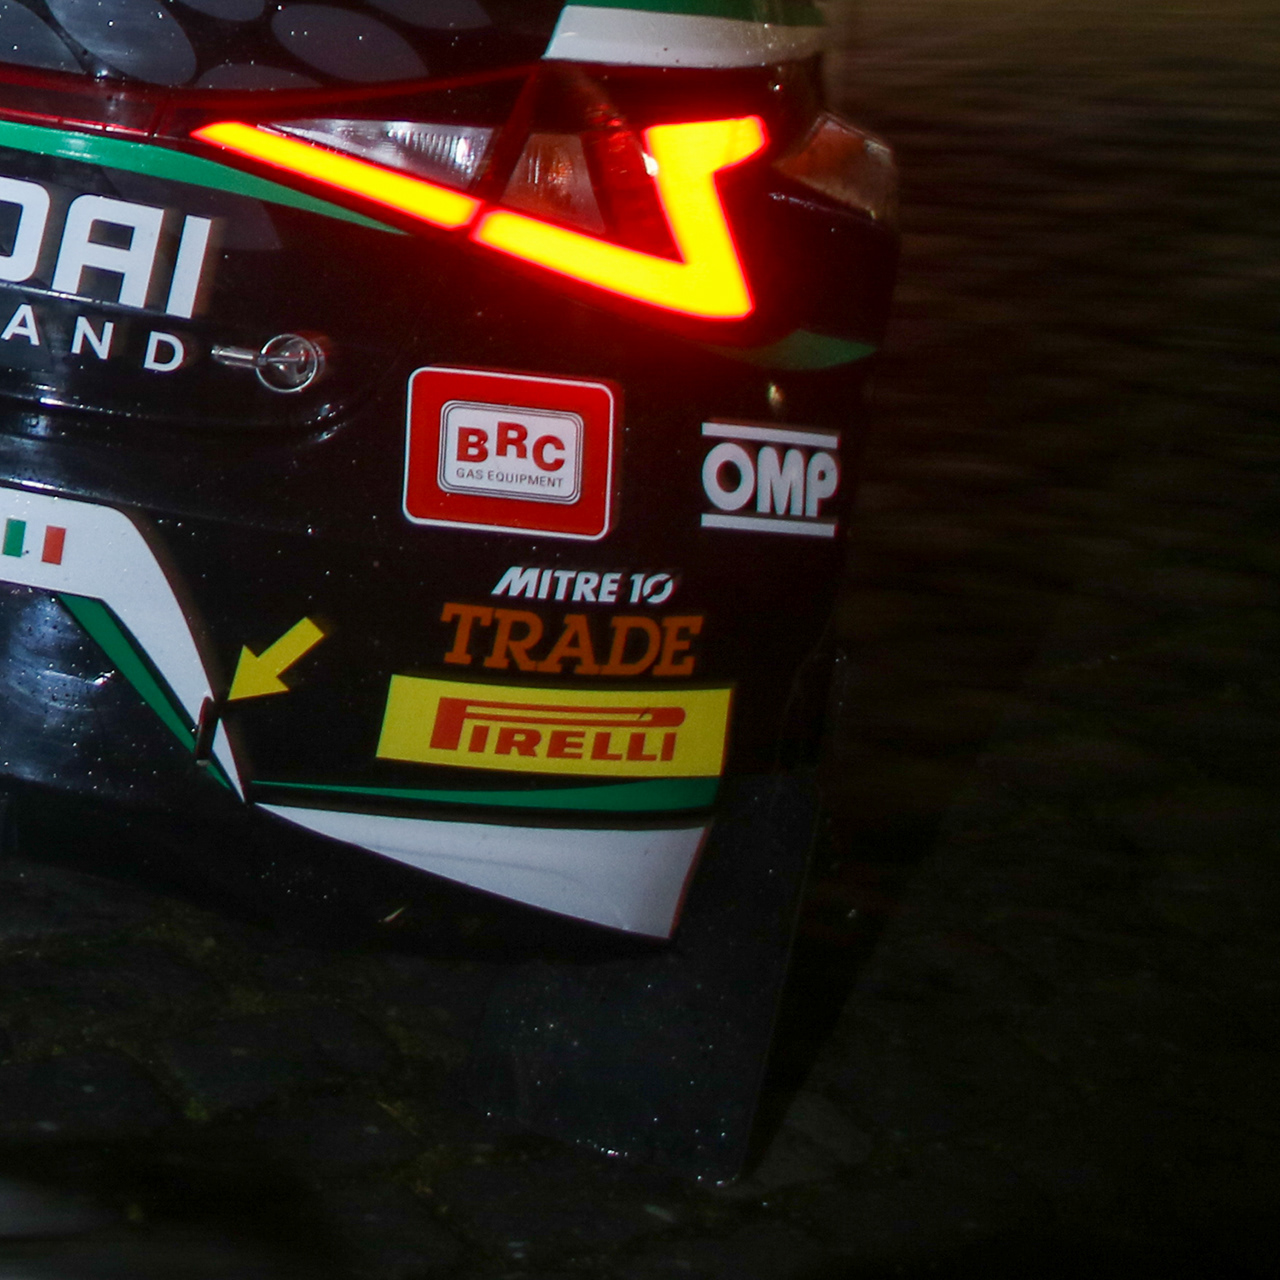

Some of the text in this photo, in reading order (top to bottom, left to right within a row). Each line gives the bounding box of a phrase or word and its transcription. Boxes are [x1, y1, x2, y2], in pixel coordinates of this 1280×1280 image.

[455, 420, 566, 473] BRC
[456, 467, 565, 489] GAS EQUIPMENT
[701, 442, 838, 518] OMP
[490, 566, 675, 605] MITRE 10
[441, 601, 704, 678] TRADE
[429, 696, 687, 763] PIRELLI
